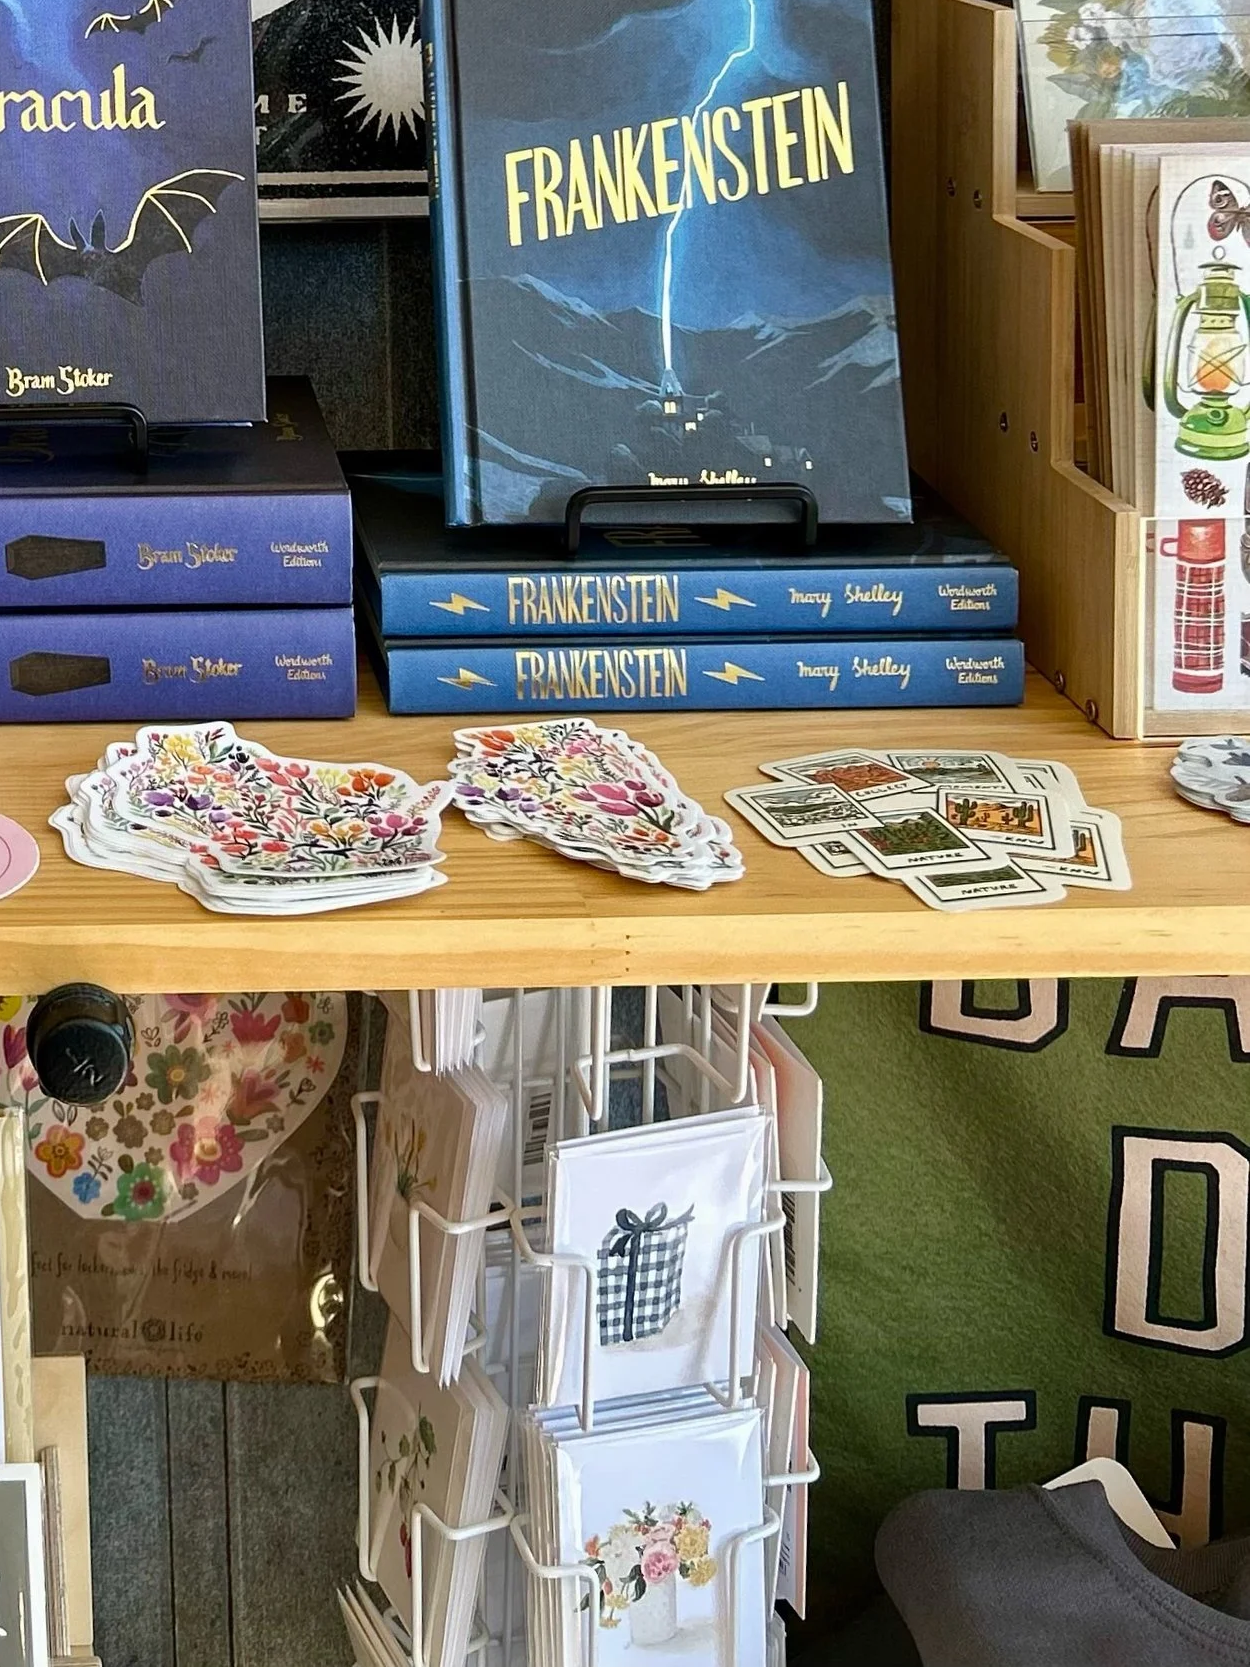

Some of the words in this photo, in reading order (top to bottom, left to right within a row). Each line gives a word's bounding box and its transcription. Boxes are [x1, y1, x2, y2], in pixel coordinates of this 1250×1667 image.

[504, 80, 855, 248] FRANKENSTEIN
[4, 365, 55, 398] Bram
[56, 364, 114, 396] Stoker
[270, 540, 329, 555] Wordsworth
[136, 541, 183, 571] Bram
[183, 541, 239, 569] Stoker
[282, 555, 322, 568] Editions
[937, 583, 998, 598] Wordsworth
[506, 574, 680, 626] FRANKENSTEIN
[787, 587, 833, 619] Mary
[843, 583, 904, 617] Shelley
[949, 598, 991, 612] Editions
[274, 652, 333, 668] Wordsworth
[945, 655, 1006, 671] Wordsworth
[141, 656, 187, 685] Bram
[189, 654, 244, 684] Stoker
[286, 668, 327, 681] Editions
[514, 647, 688, 701] FRANKENSTEIN
[796, 661, 840, 692] Mary
[851, 655, 911, 690] Shelley
[957, 671, 998, 685] Editions
[855, 782, 909, 798] COLLECT
[907, 852, 964, 864] NATURE
[960, 882, 1019, 896] NATURE
[60, 1319, 138, 1340] natural
[170, 1320, 204, 1342] life
